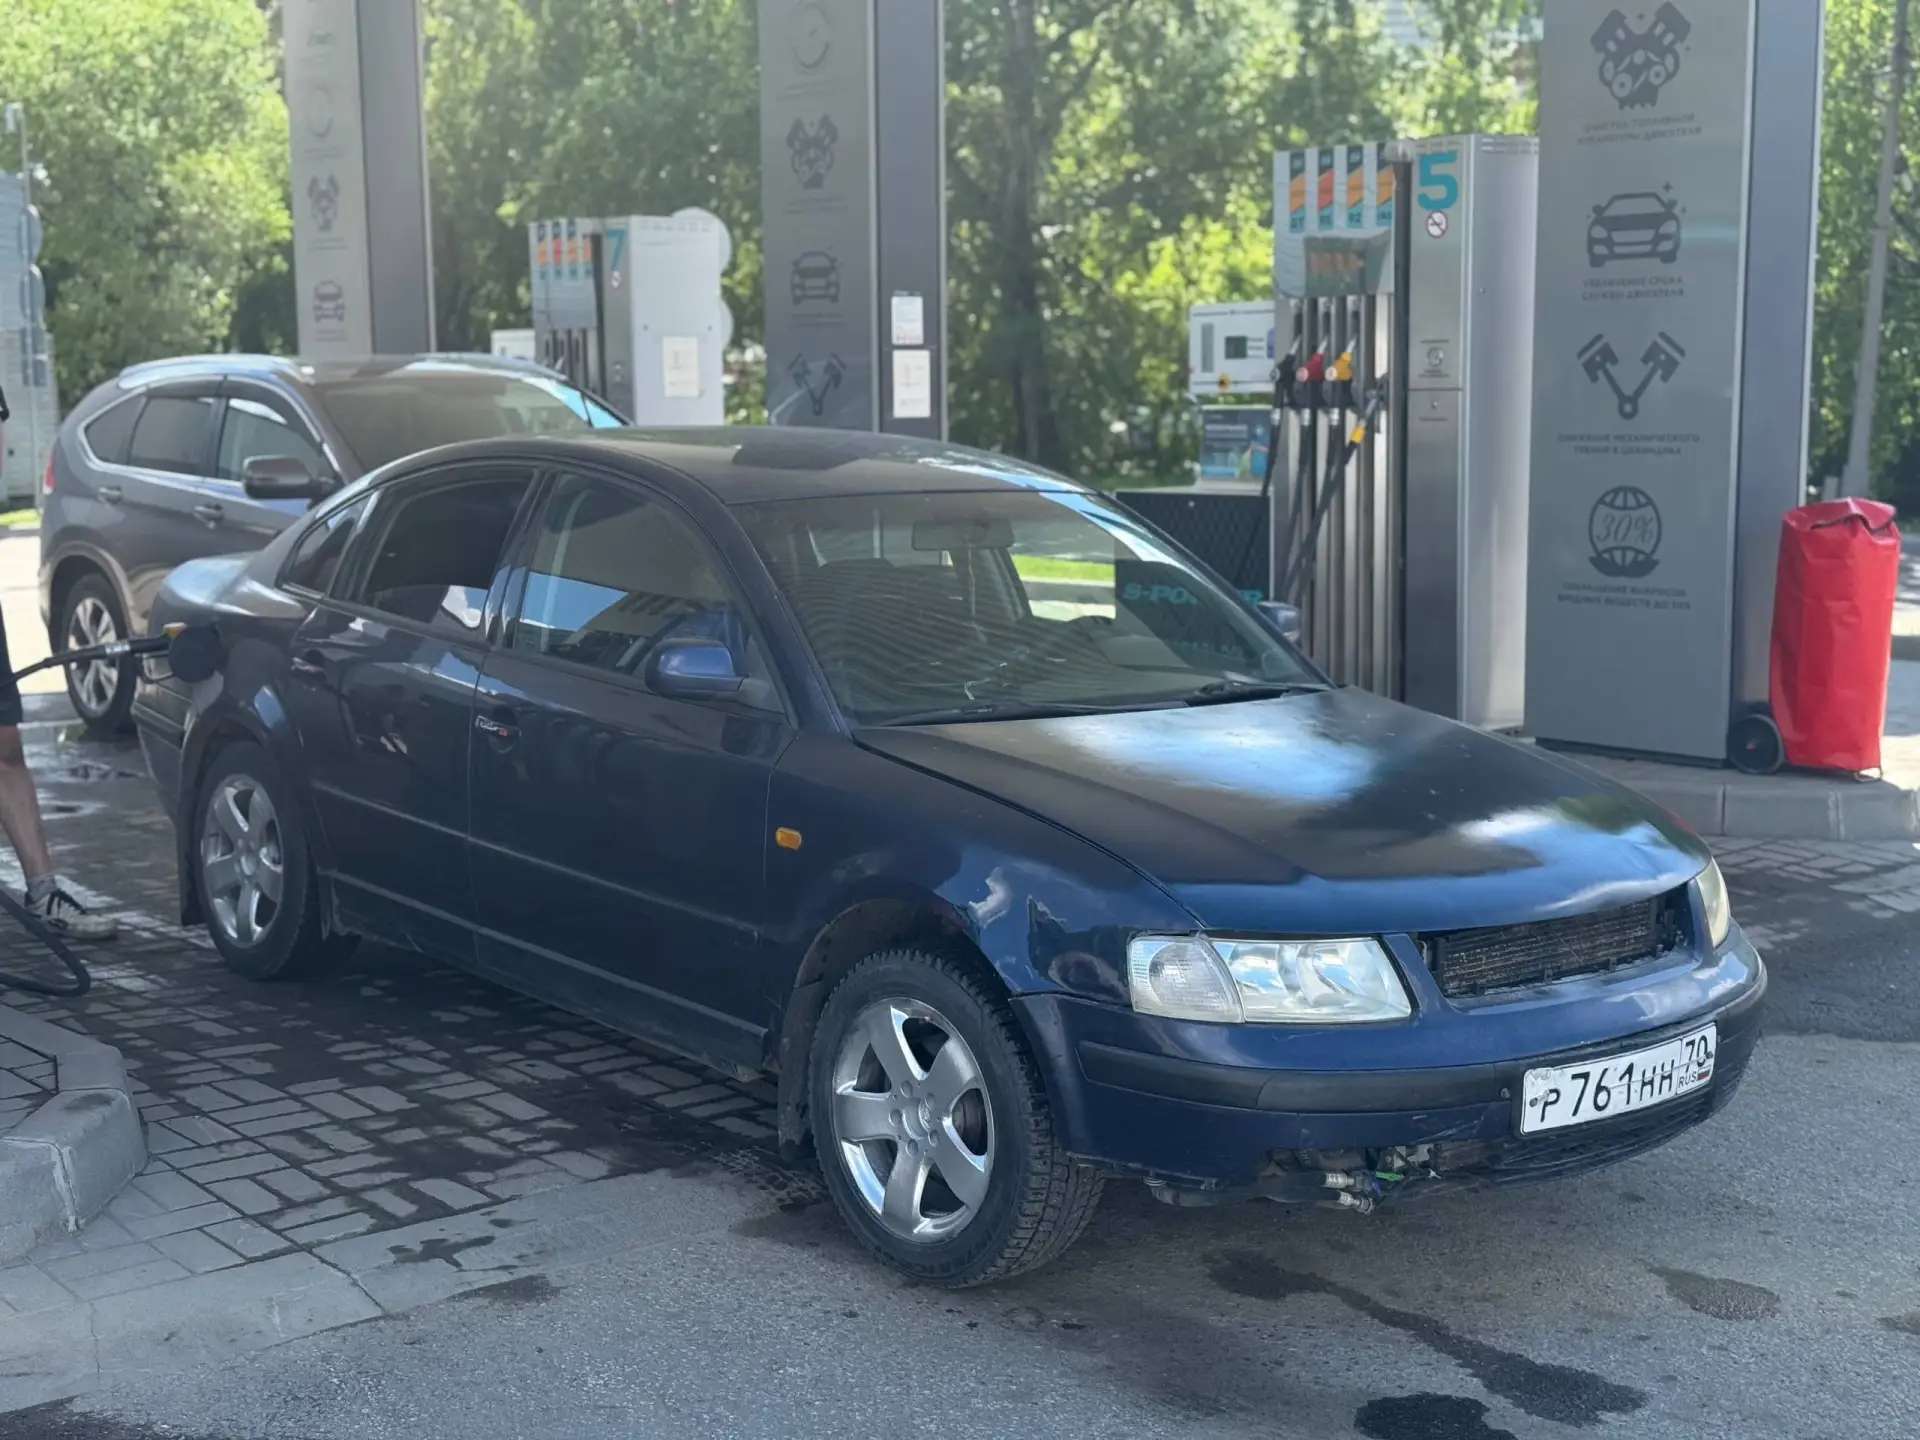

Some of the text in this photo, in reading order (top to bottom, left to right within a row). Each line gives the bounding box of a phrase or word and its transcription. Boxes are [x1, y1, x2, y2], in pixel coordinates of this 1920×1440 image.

[1418, 152, 1458, 210] 5
[605, 229, 626, 271] 7
[1597, 512, 1654, 545] 30%
[1686, 1034, 1708, 1073] 70
[1678, 1070, 1697, 1088] RUS
